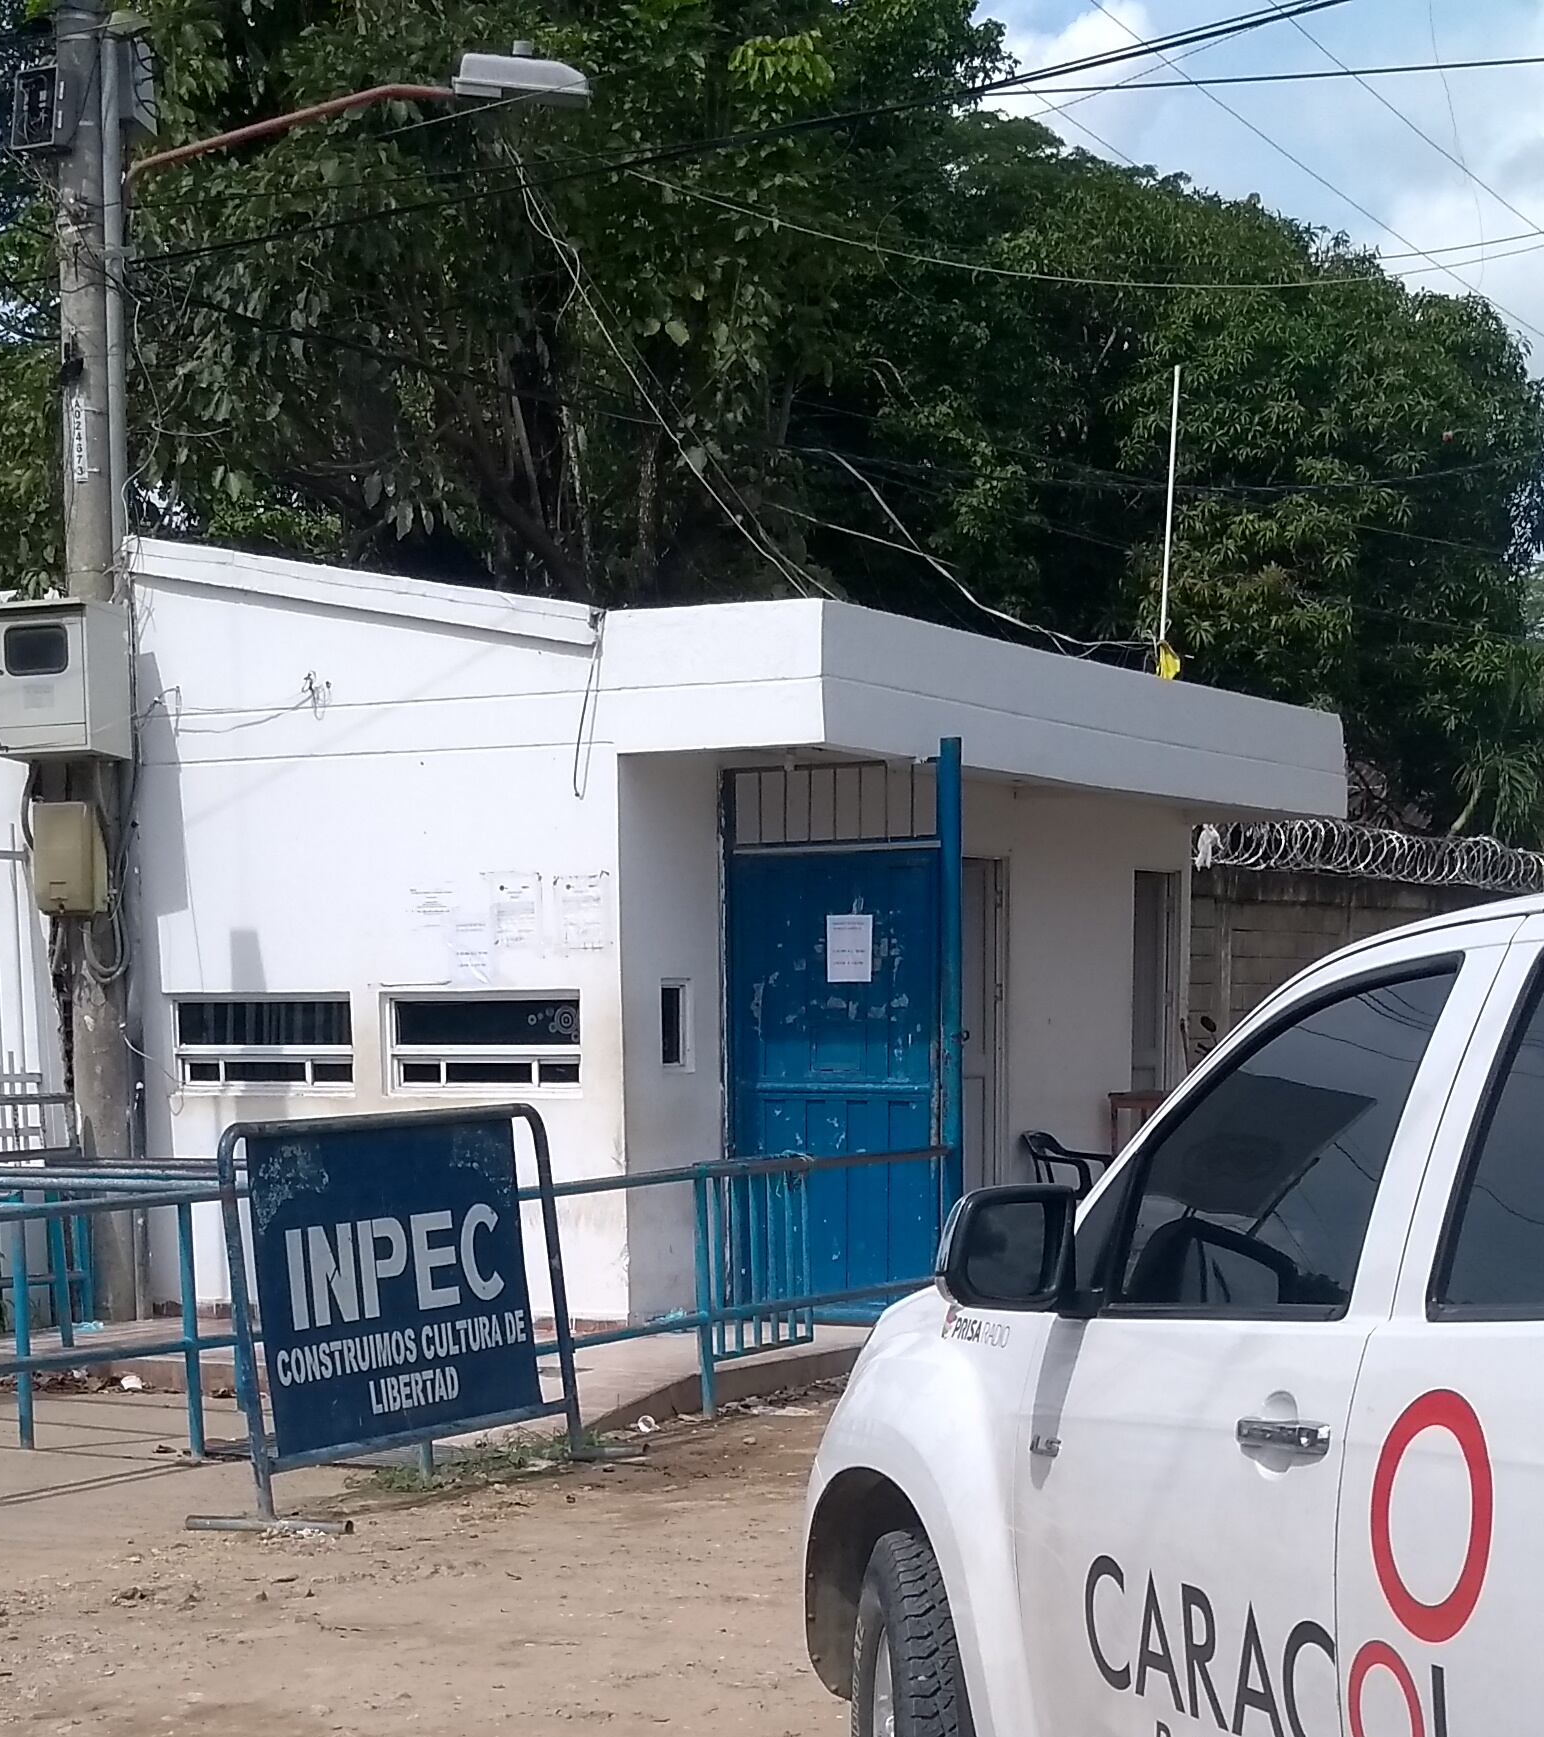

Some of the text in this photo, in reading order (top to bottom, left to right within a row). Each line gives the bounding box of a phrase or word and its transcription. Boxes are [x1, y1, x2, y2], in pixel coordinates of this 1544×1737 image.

[285, 1203, 505, 1331] INPEC
[276, 1308, 527, 1387] CONSTRUIMOS CULTURA DE
[951, 1317, 983, 1343] PRISA
[368, 1366, 460, 1416] LIBERTAD
